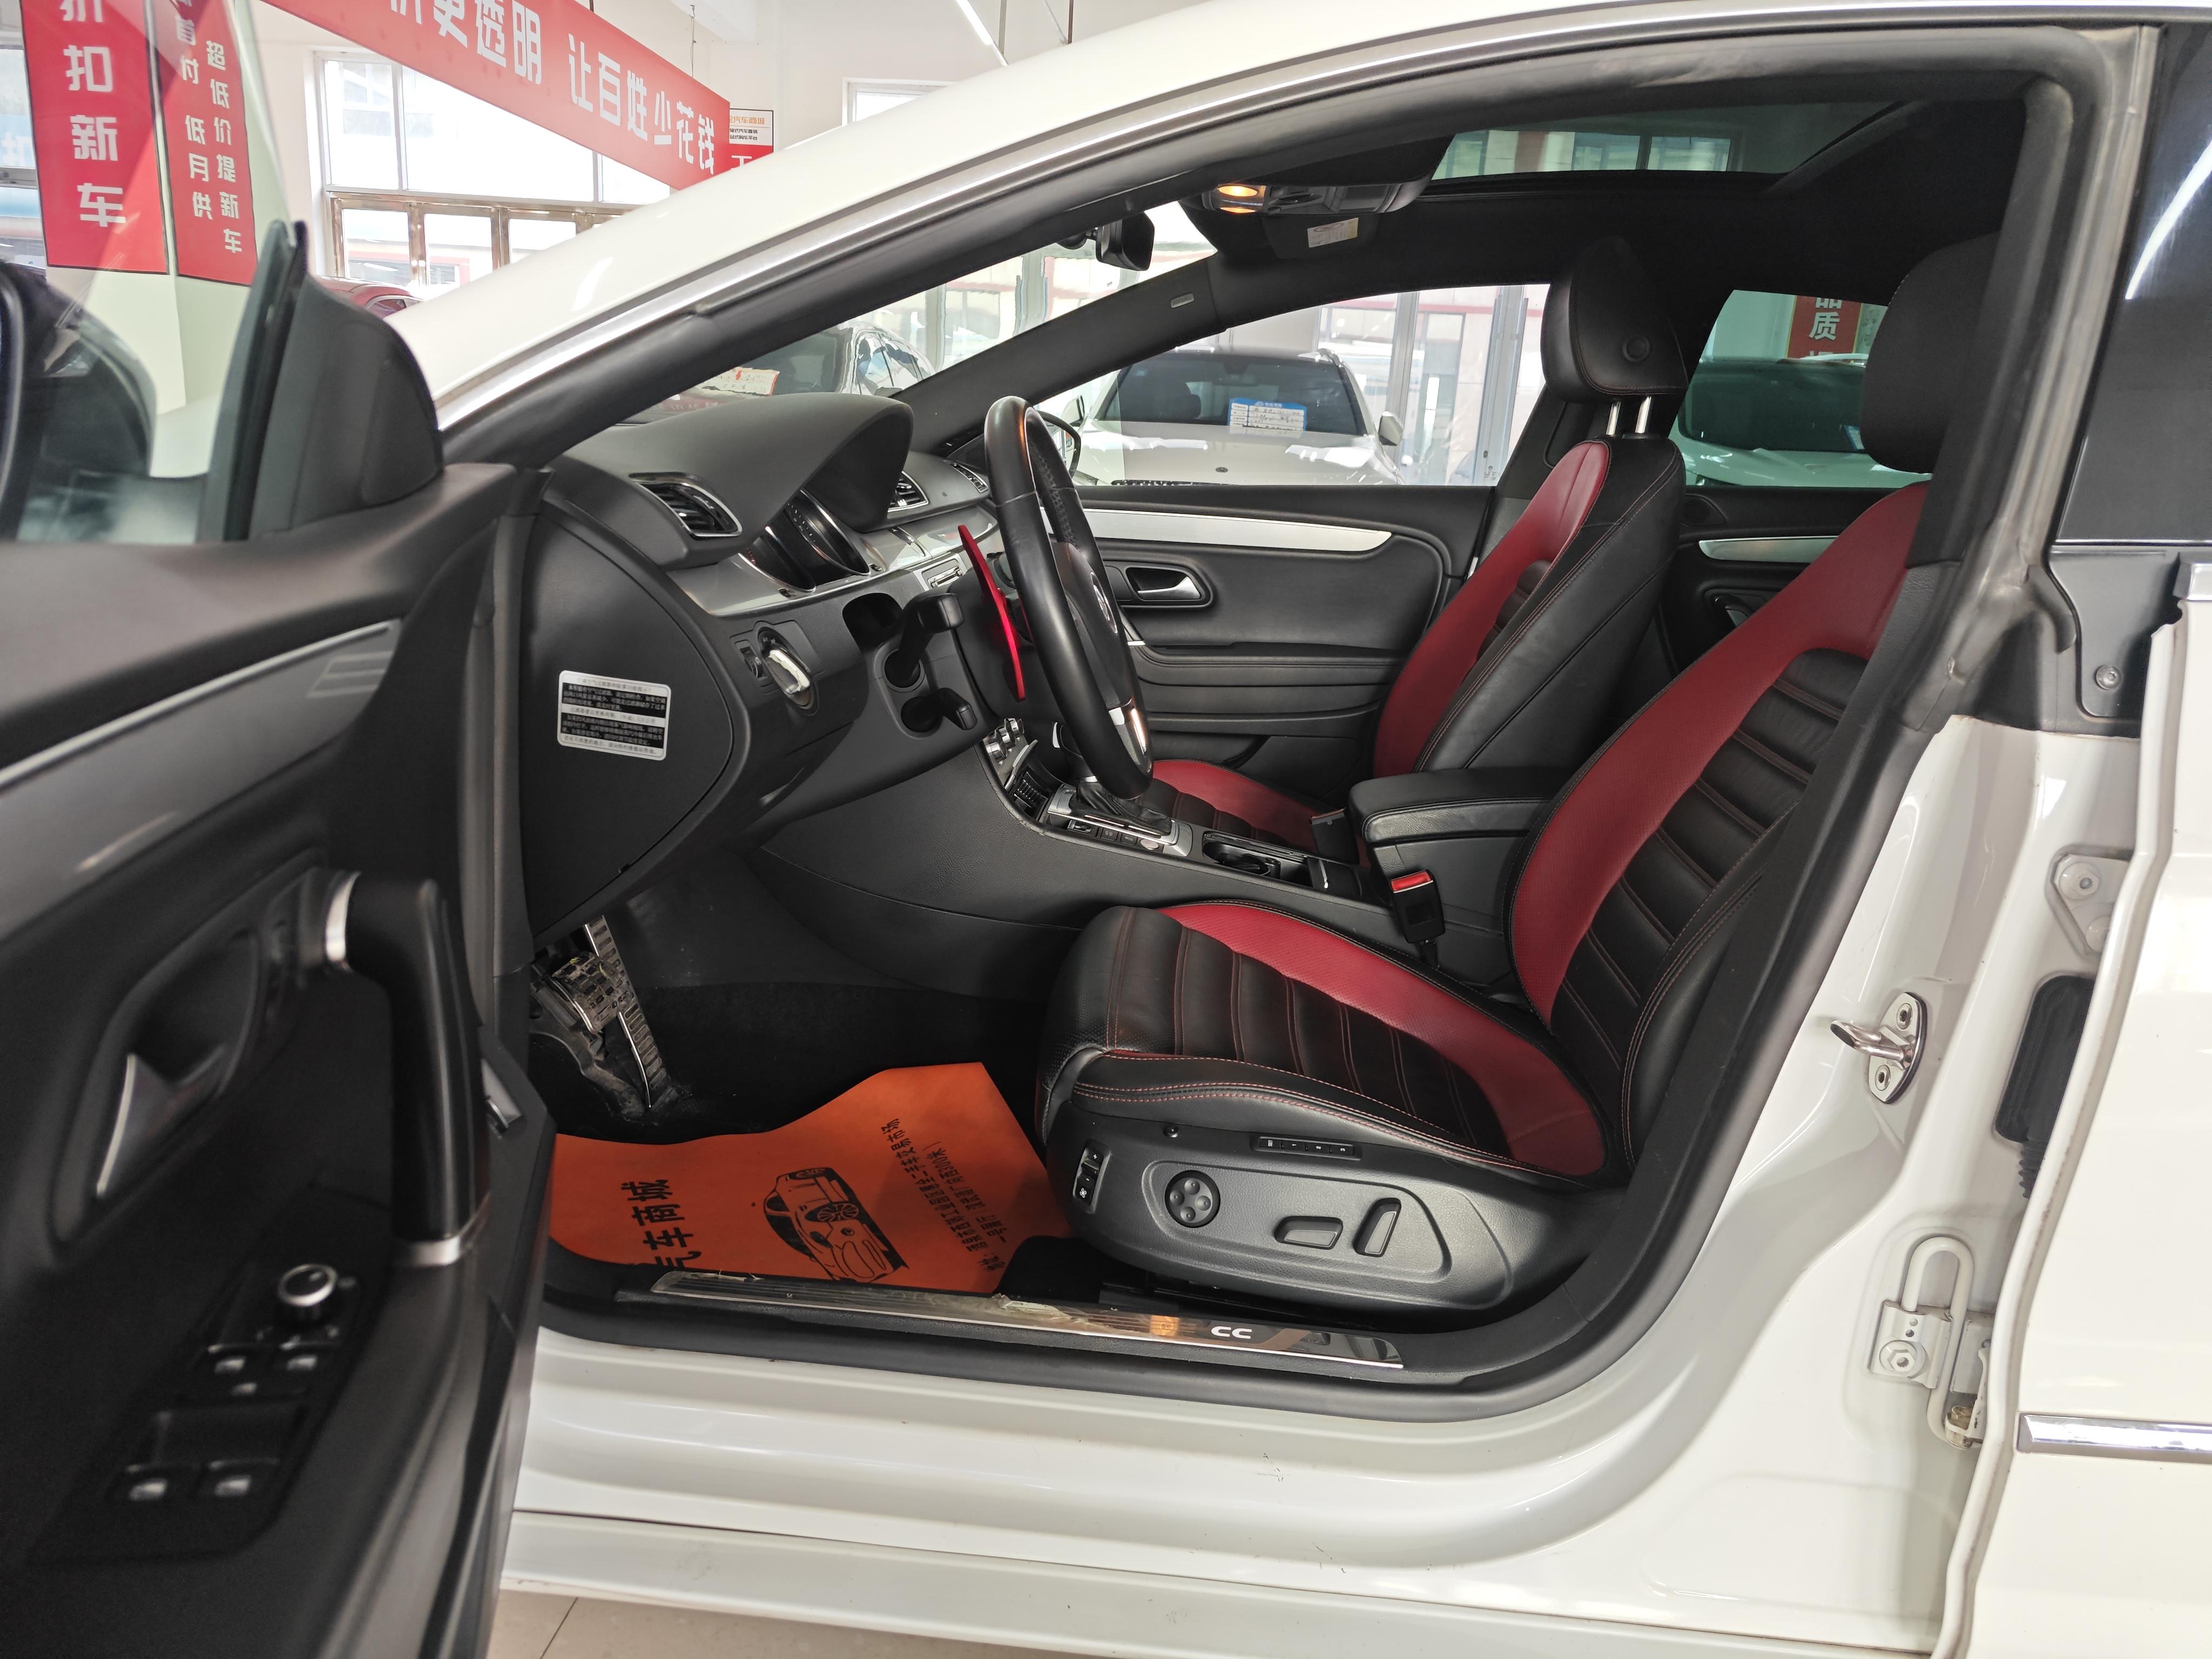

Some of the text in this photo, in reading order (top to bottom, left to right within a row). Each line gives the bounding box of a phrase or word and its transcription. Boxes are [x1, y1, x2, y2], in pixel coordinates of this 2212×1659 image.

[174, 0, 213, 220] 首付 低月供
[206, 40, 242, 254] 超低价提新车
[568, 33, 714, 175] 让百姓少花钱
[1211, 1326, 1252, 1339] CC
